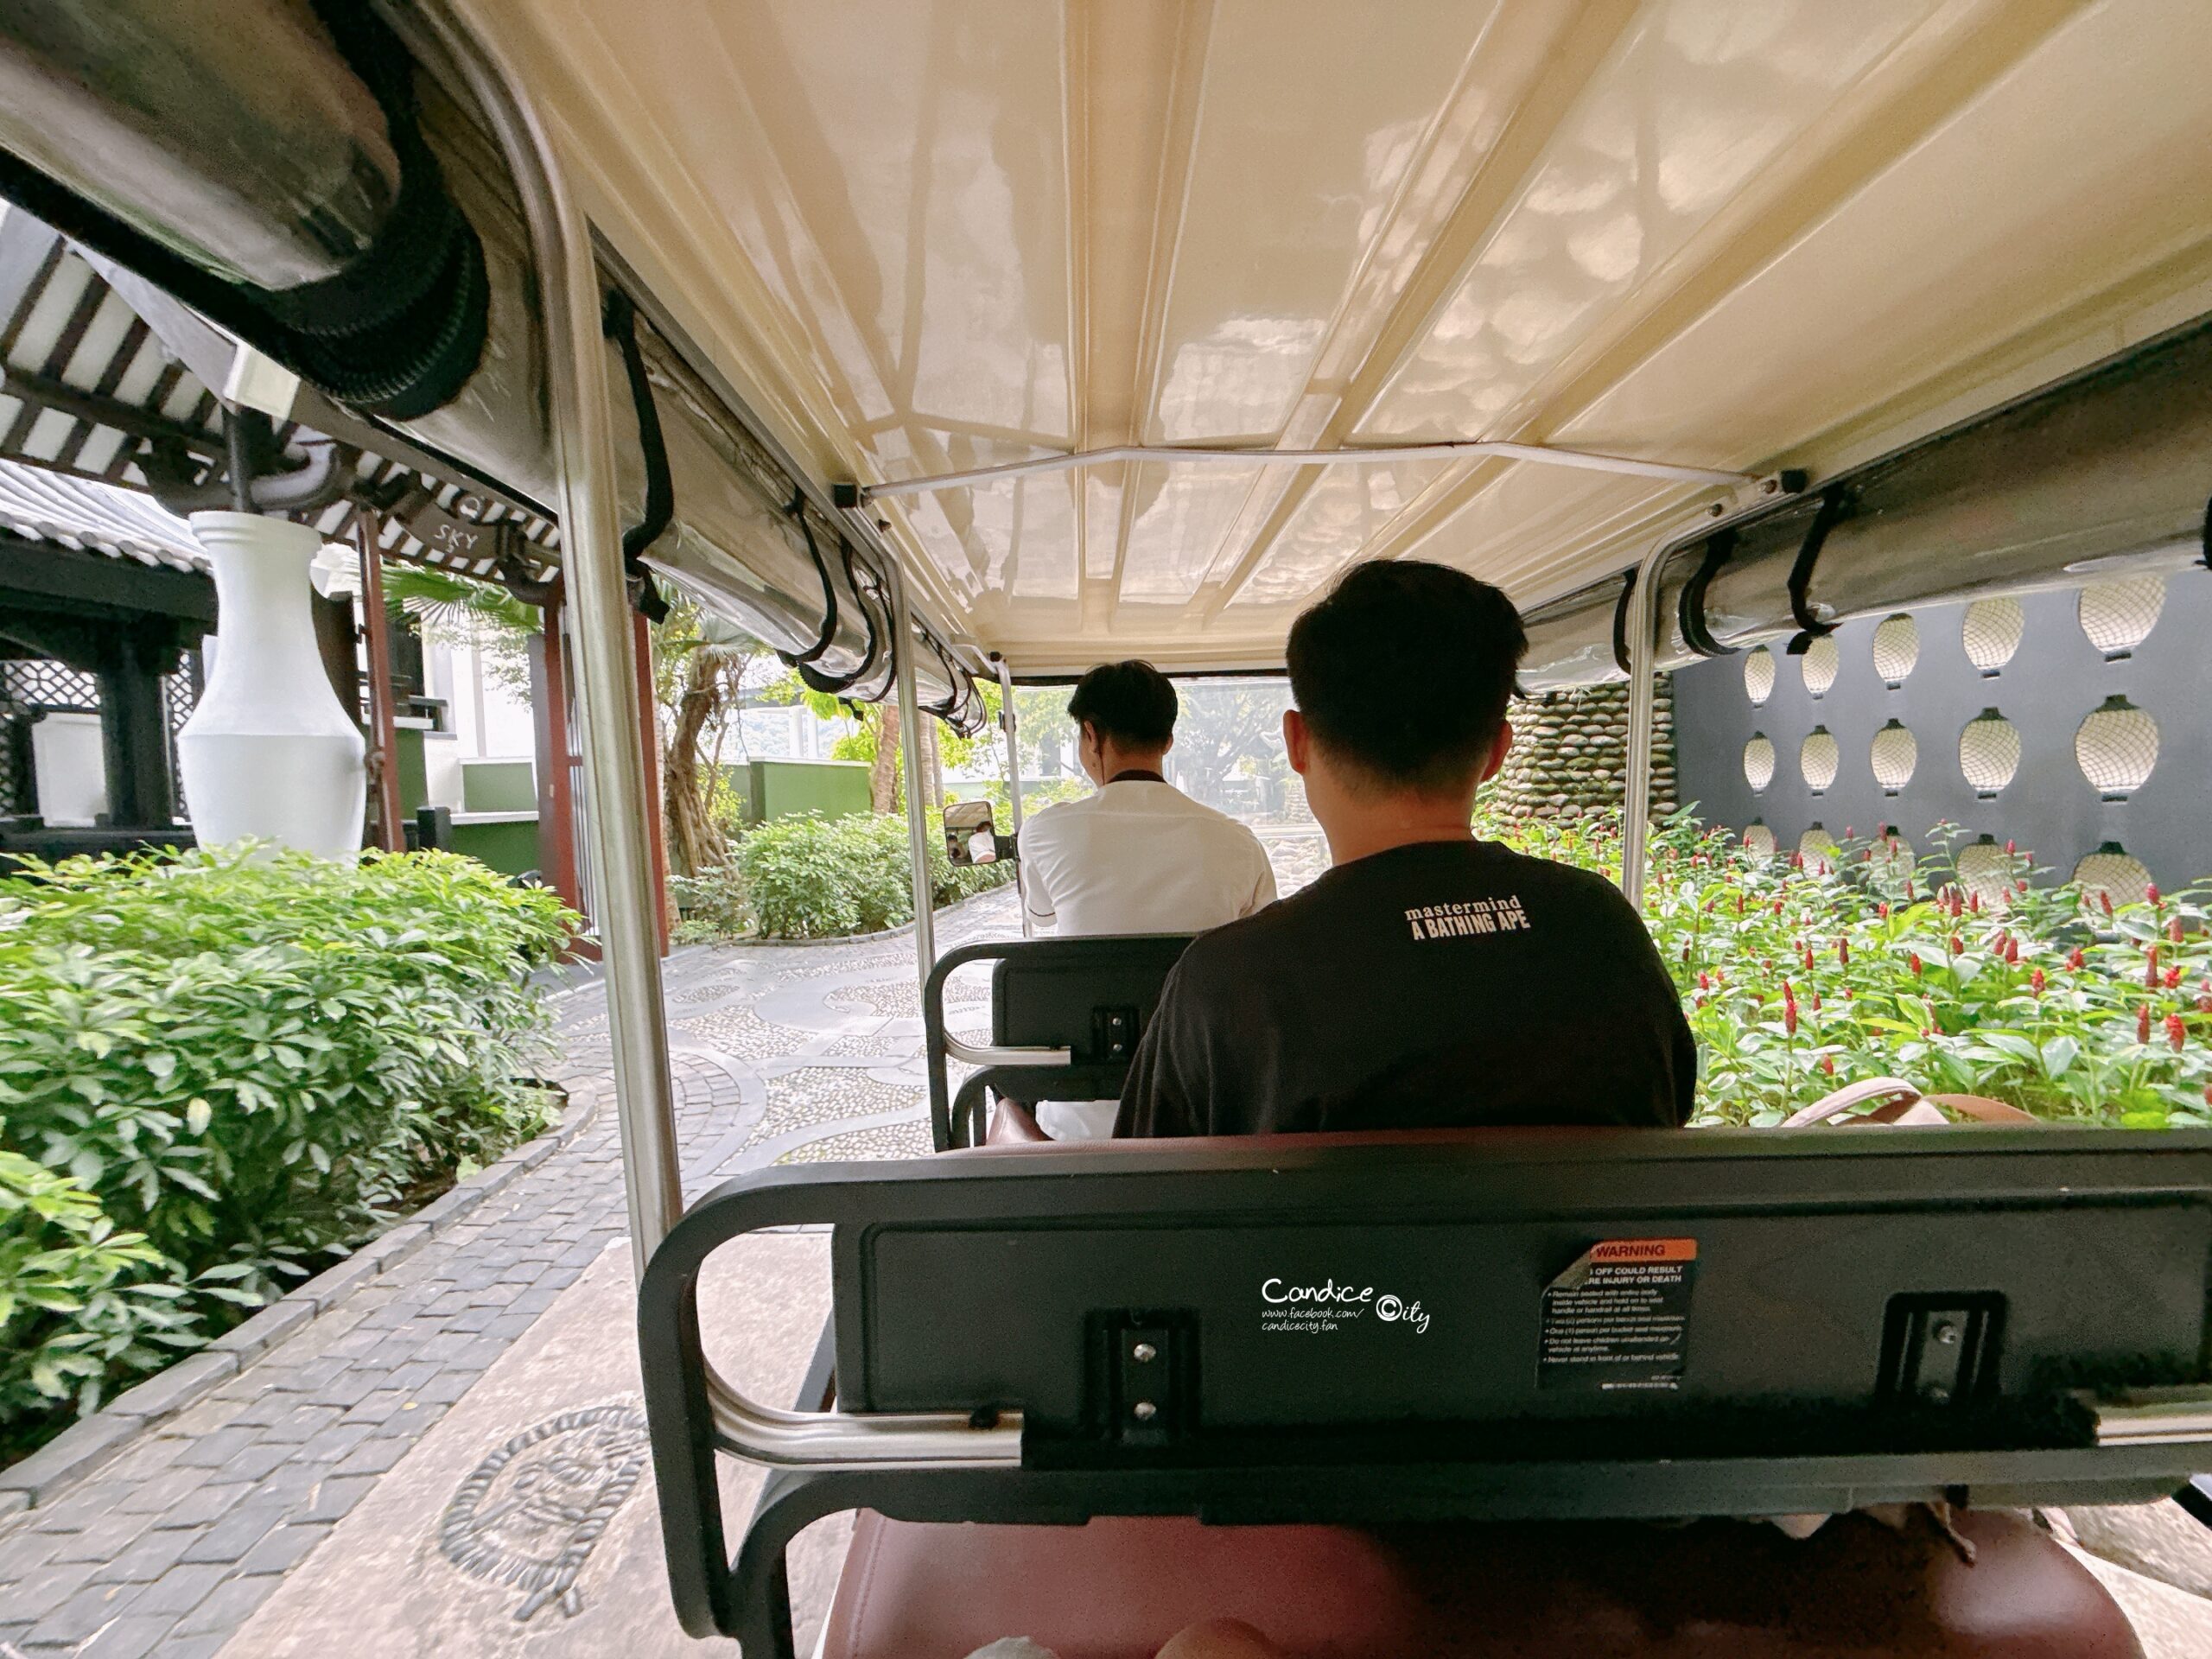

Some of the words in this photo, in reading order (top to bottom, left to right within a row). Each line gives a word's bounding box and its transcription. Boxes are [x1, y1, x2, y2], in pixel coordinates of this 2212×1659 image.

[434, 524, 479, 550] SKY
[1404, 894, 1522, 921] mastermind
[1410, 920, 1426, 940] A
[1425, 913, 1497, 938] BATHING
[1497, 910, 1531, 931] APE
[1596, 1244, 1666, 1258] WARNING
[1614, 1267, 1646, 1275] COULD
[1651, 1274, 1681, 1283] DEATH
